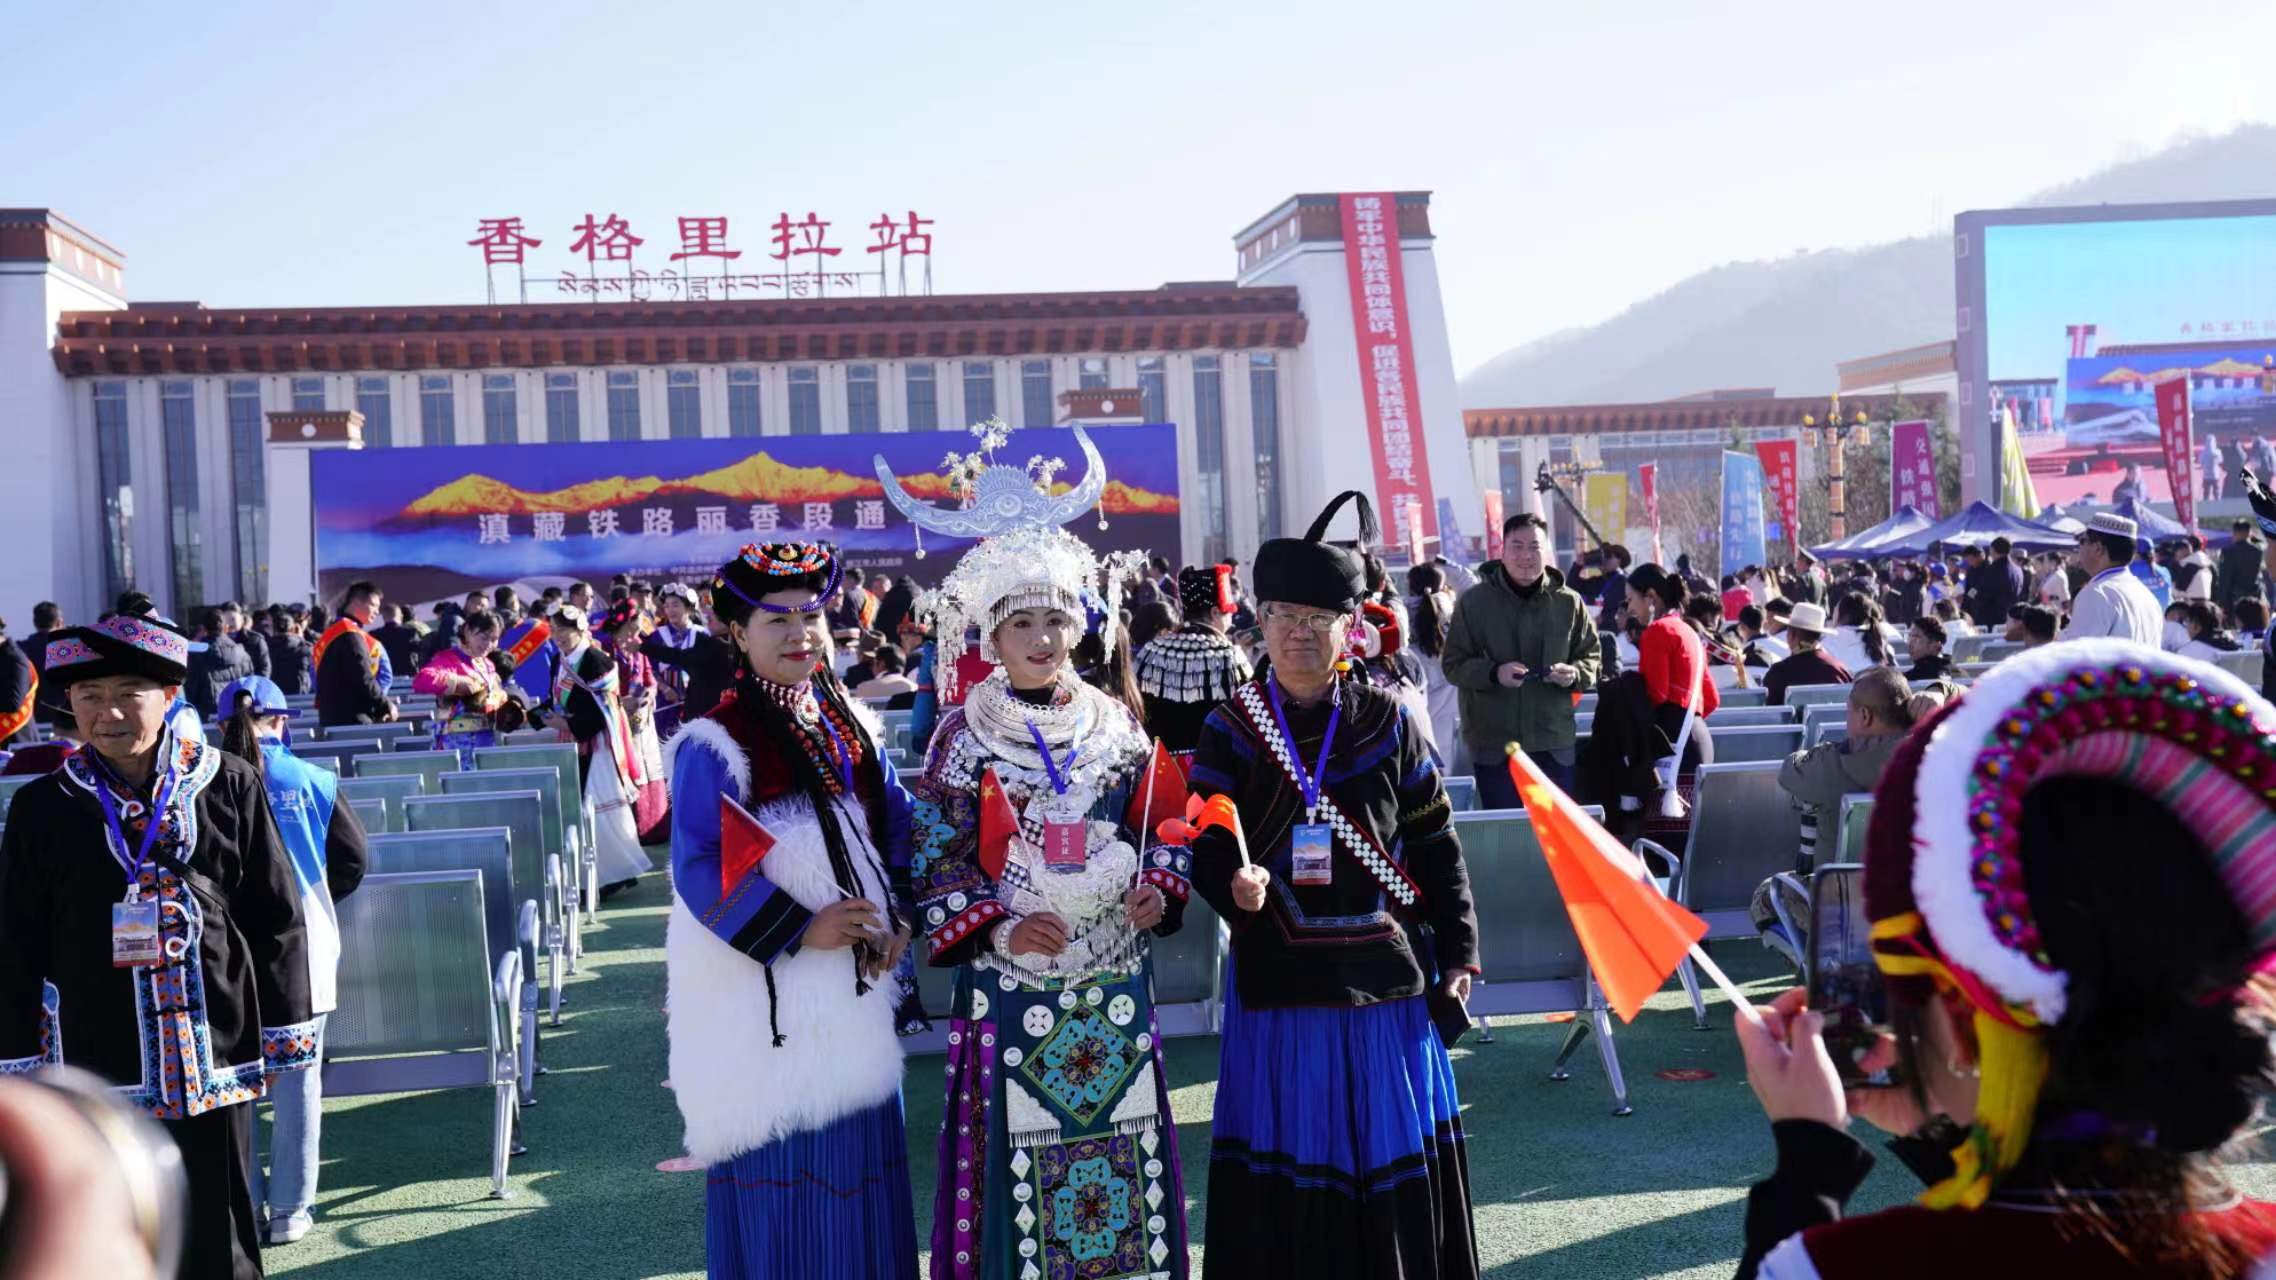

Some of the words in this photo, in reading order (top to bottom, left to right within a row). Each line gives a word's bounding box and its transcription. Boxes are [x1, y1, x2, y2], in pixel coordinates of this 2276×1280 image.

[468, 211, 934, 265] 香格里拉站
[479, 499, 936, 545] 滇藏铁路丽香段通
